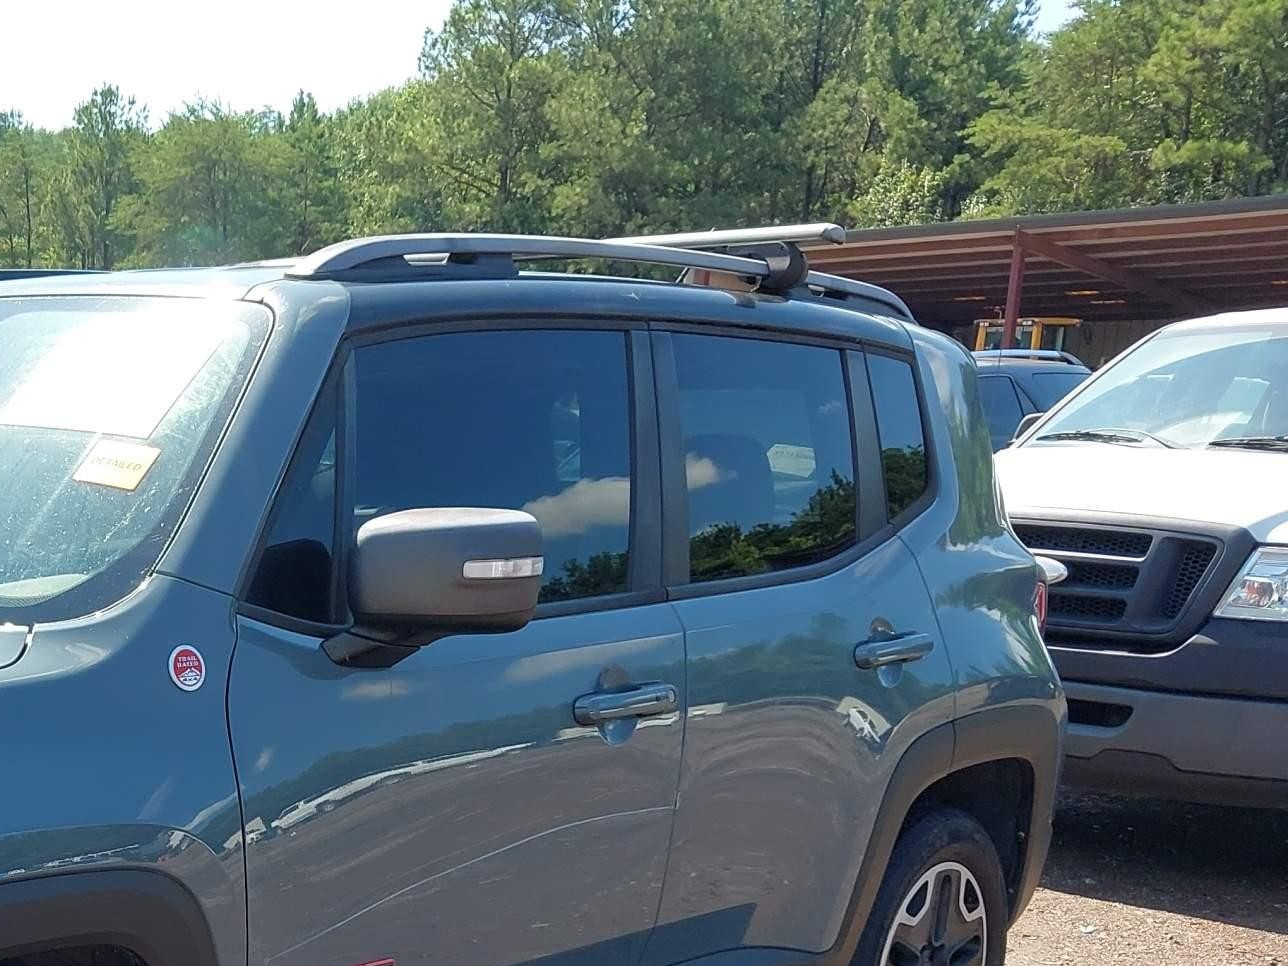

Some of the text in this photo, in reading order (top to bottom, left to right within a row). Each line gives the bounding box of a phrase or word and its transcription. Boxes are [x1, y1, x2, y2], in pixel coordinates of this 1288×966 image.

[89, 456, 143, 472] DETAILED
[177, 655, 198, 663] TRAIL
[176, 661, 199, 669] RATED
